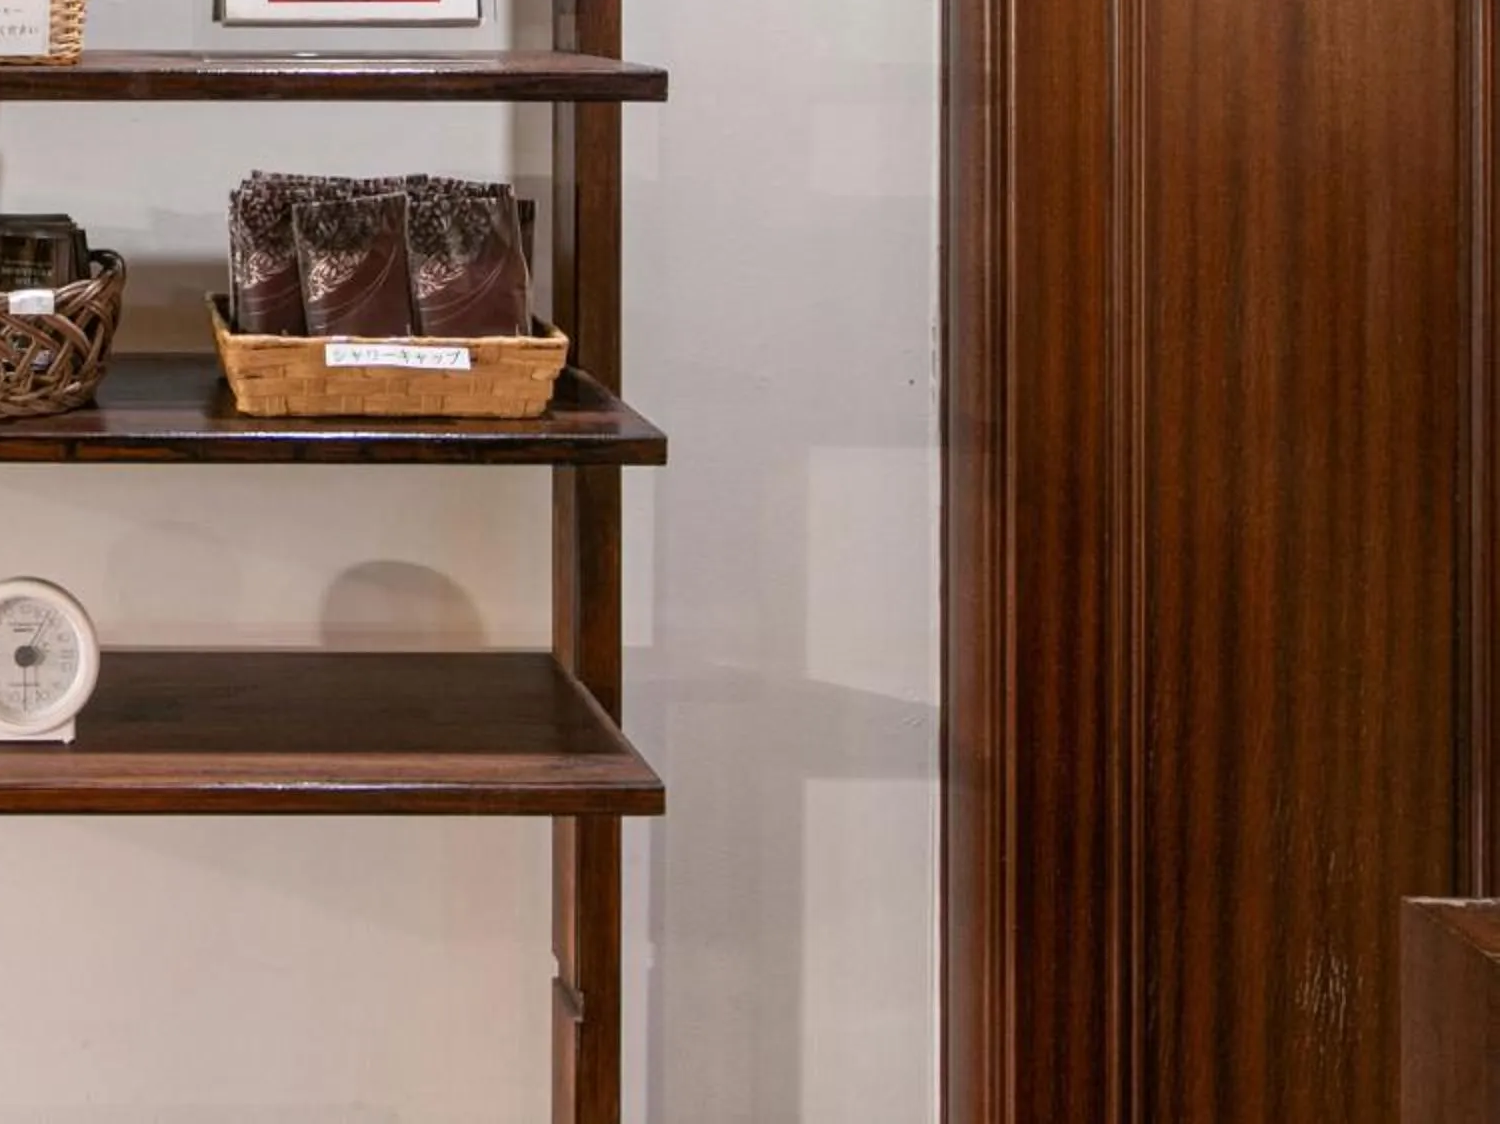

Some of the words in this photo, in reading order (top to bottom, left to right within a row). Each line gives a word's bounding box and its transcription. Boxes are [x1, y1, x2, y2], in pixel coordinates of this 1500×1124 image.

[332, 349, 461, 365] シャワーキャップ
